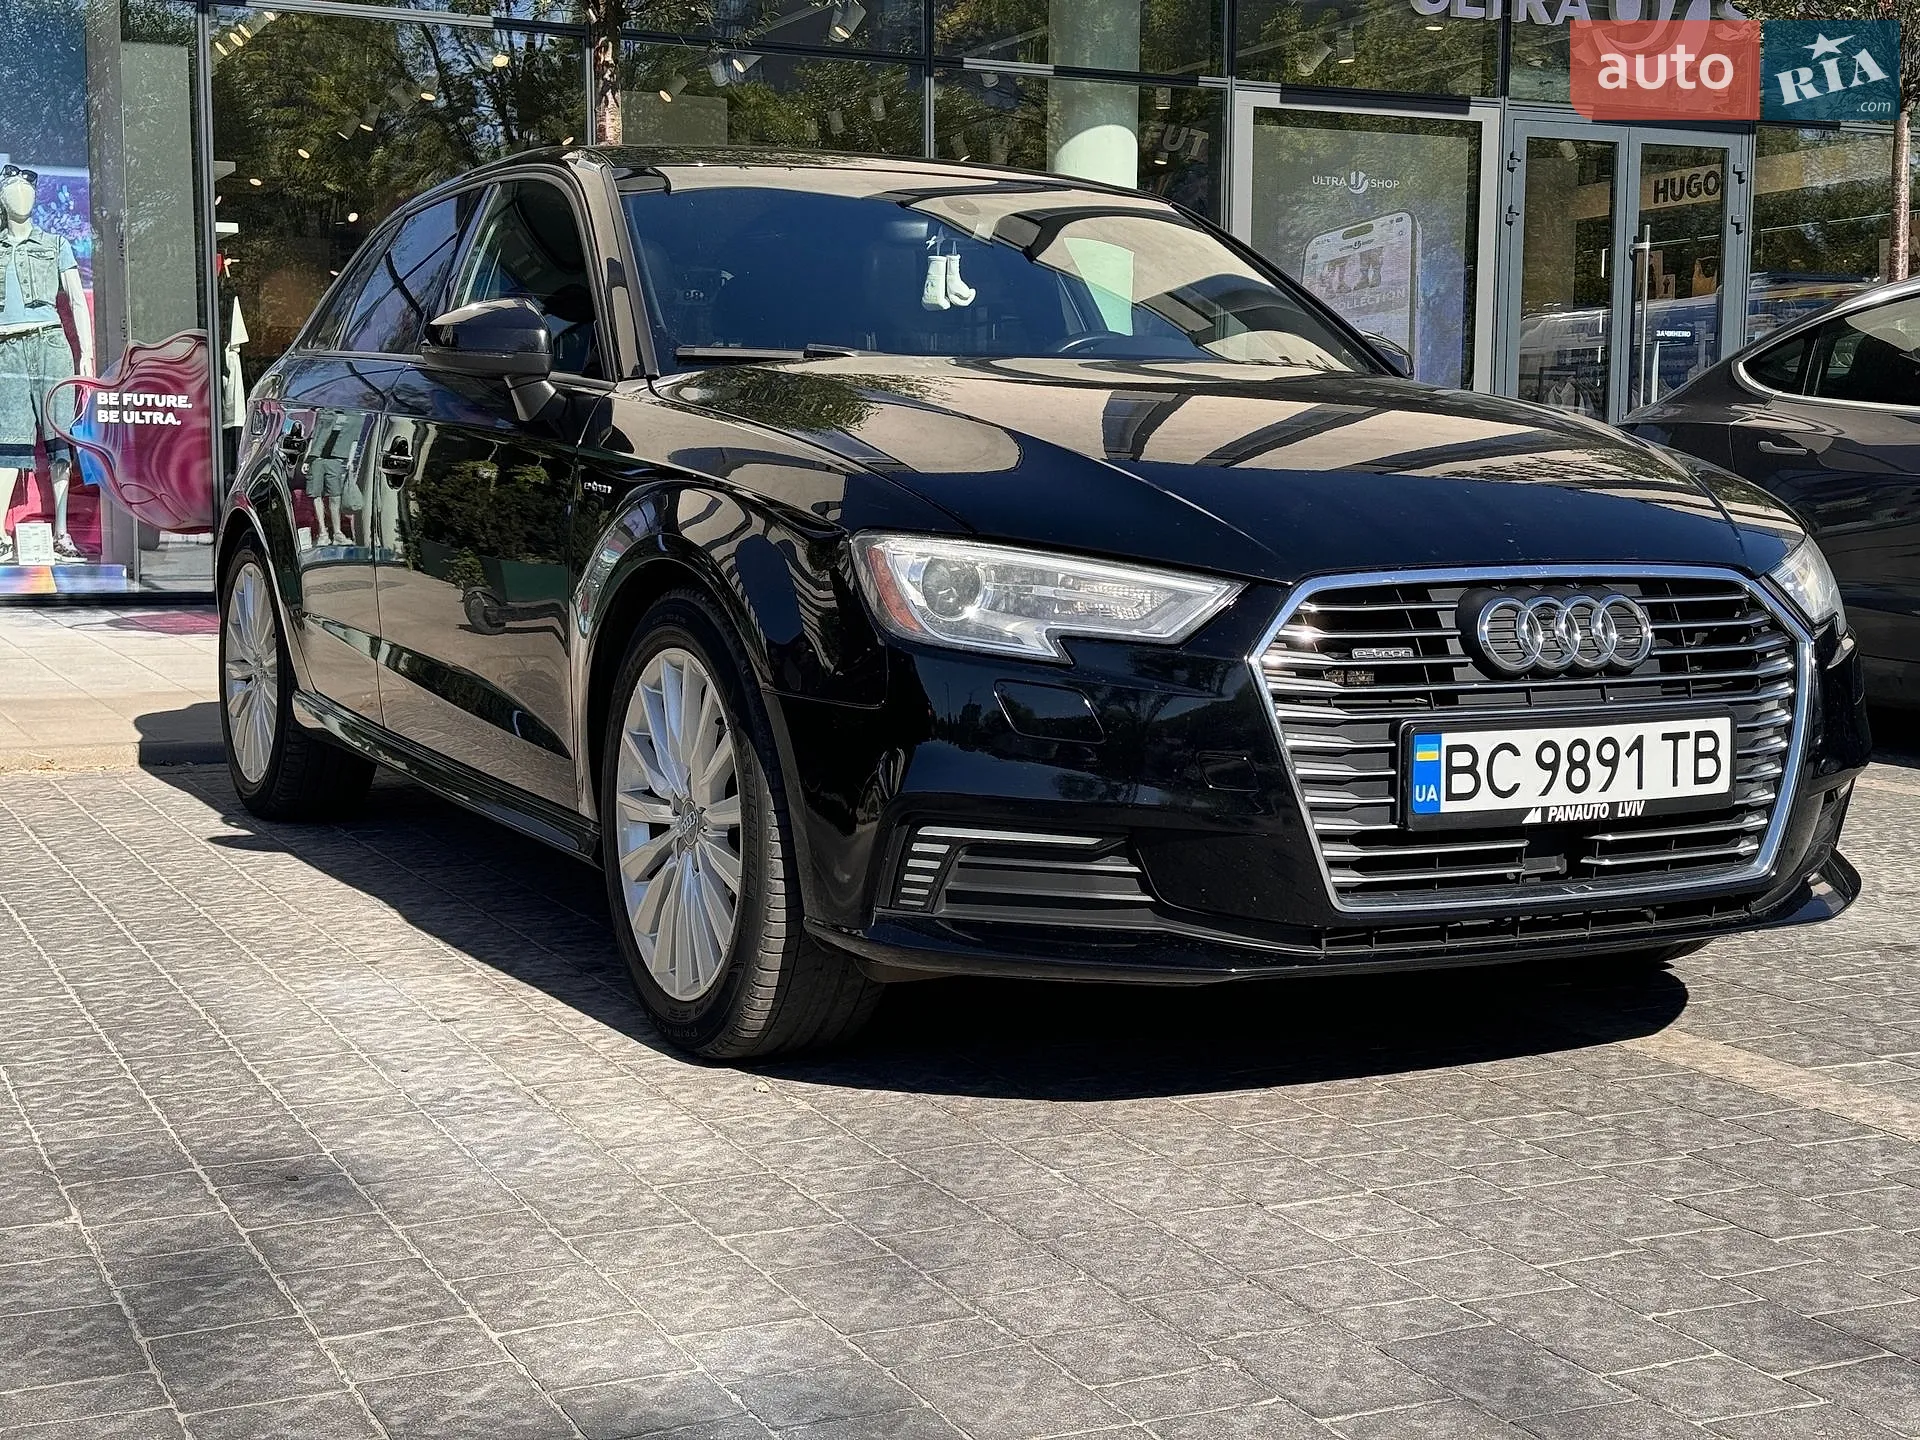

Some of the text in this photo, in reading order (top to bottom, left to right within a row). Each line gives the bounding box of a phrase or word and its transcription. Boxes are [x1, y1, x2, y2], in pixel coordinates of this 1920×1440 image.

[1312, 175, 1400, 189] ULTRA SHOP
[1653, 170, 1721, 204] HUGO
[97, 392, 192, 408] BE FUTURE.
[97, 410, 182, 426] BE ULTRA.
[1445, 729, 1722, 802] BC 9891 TB
[1415, 785, 1438, 803] UA
[1548, 801, 1645, 823] PANAUTO LVIV
